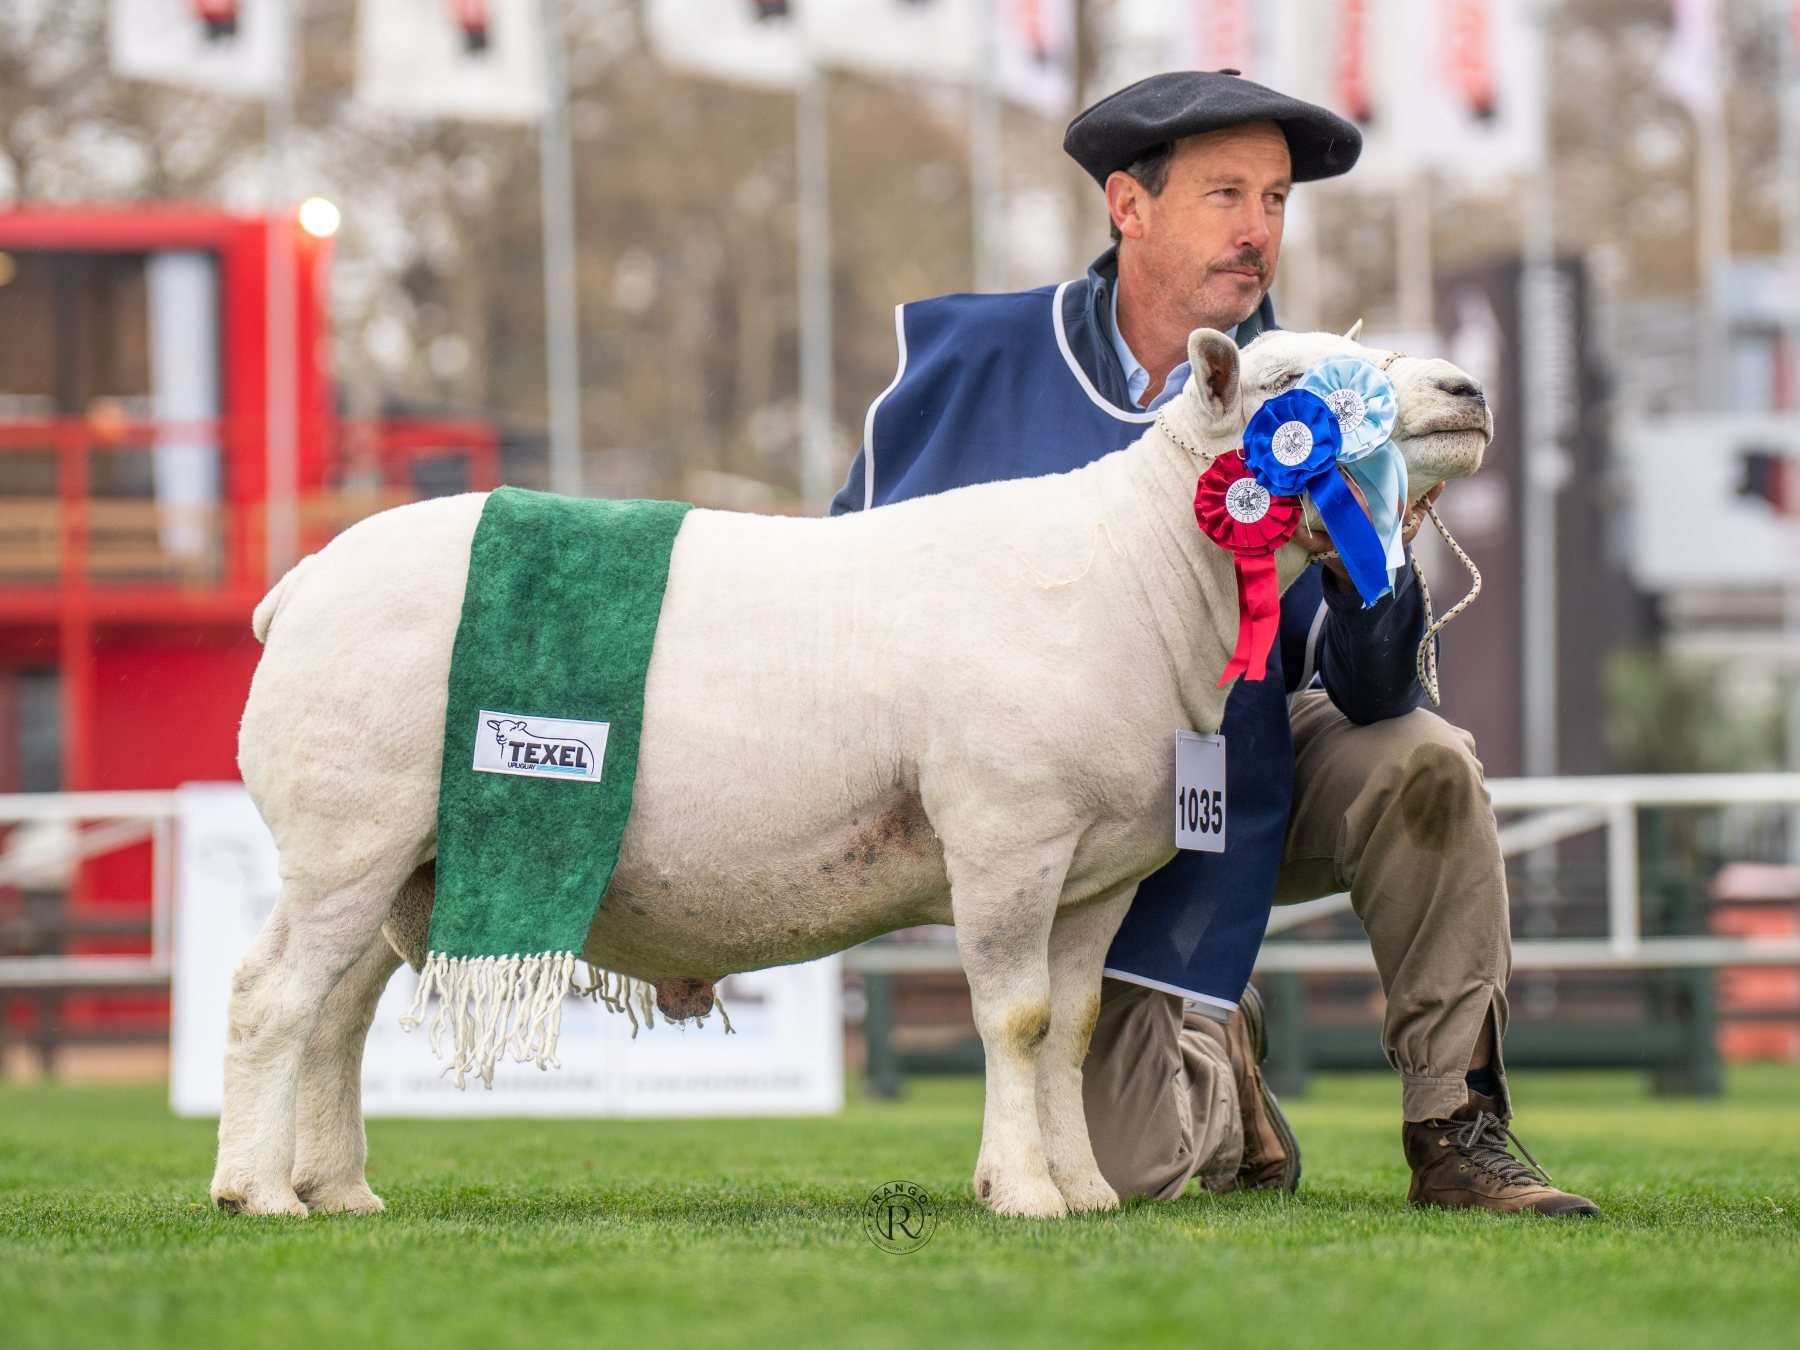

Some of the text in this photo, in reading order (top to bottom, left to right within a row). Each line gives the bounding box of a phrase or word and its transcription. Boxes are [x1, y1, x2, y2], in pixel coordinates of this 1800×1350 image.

[507, 762, 536, 770] URUGUAY
[508, 740, 588, 768] TEXEL
[1179, 786, 1222, 834] 1035
